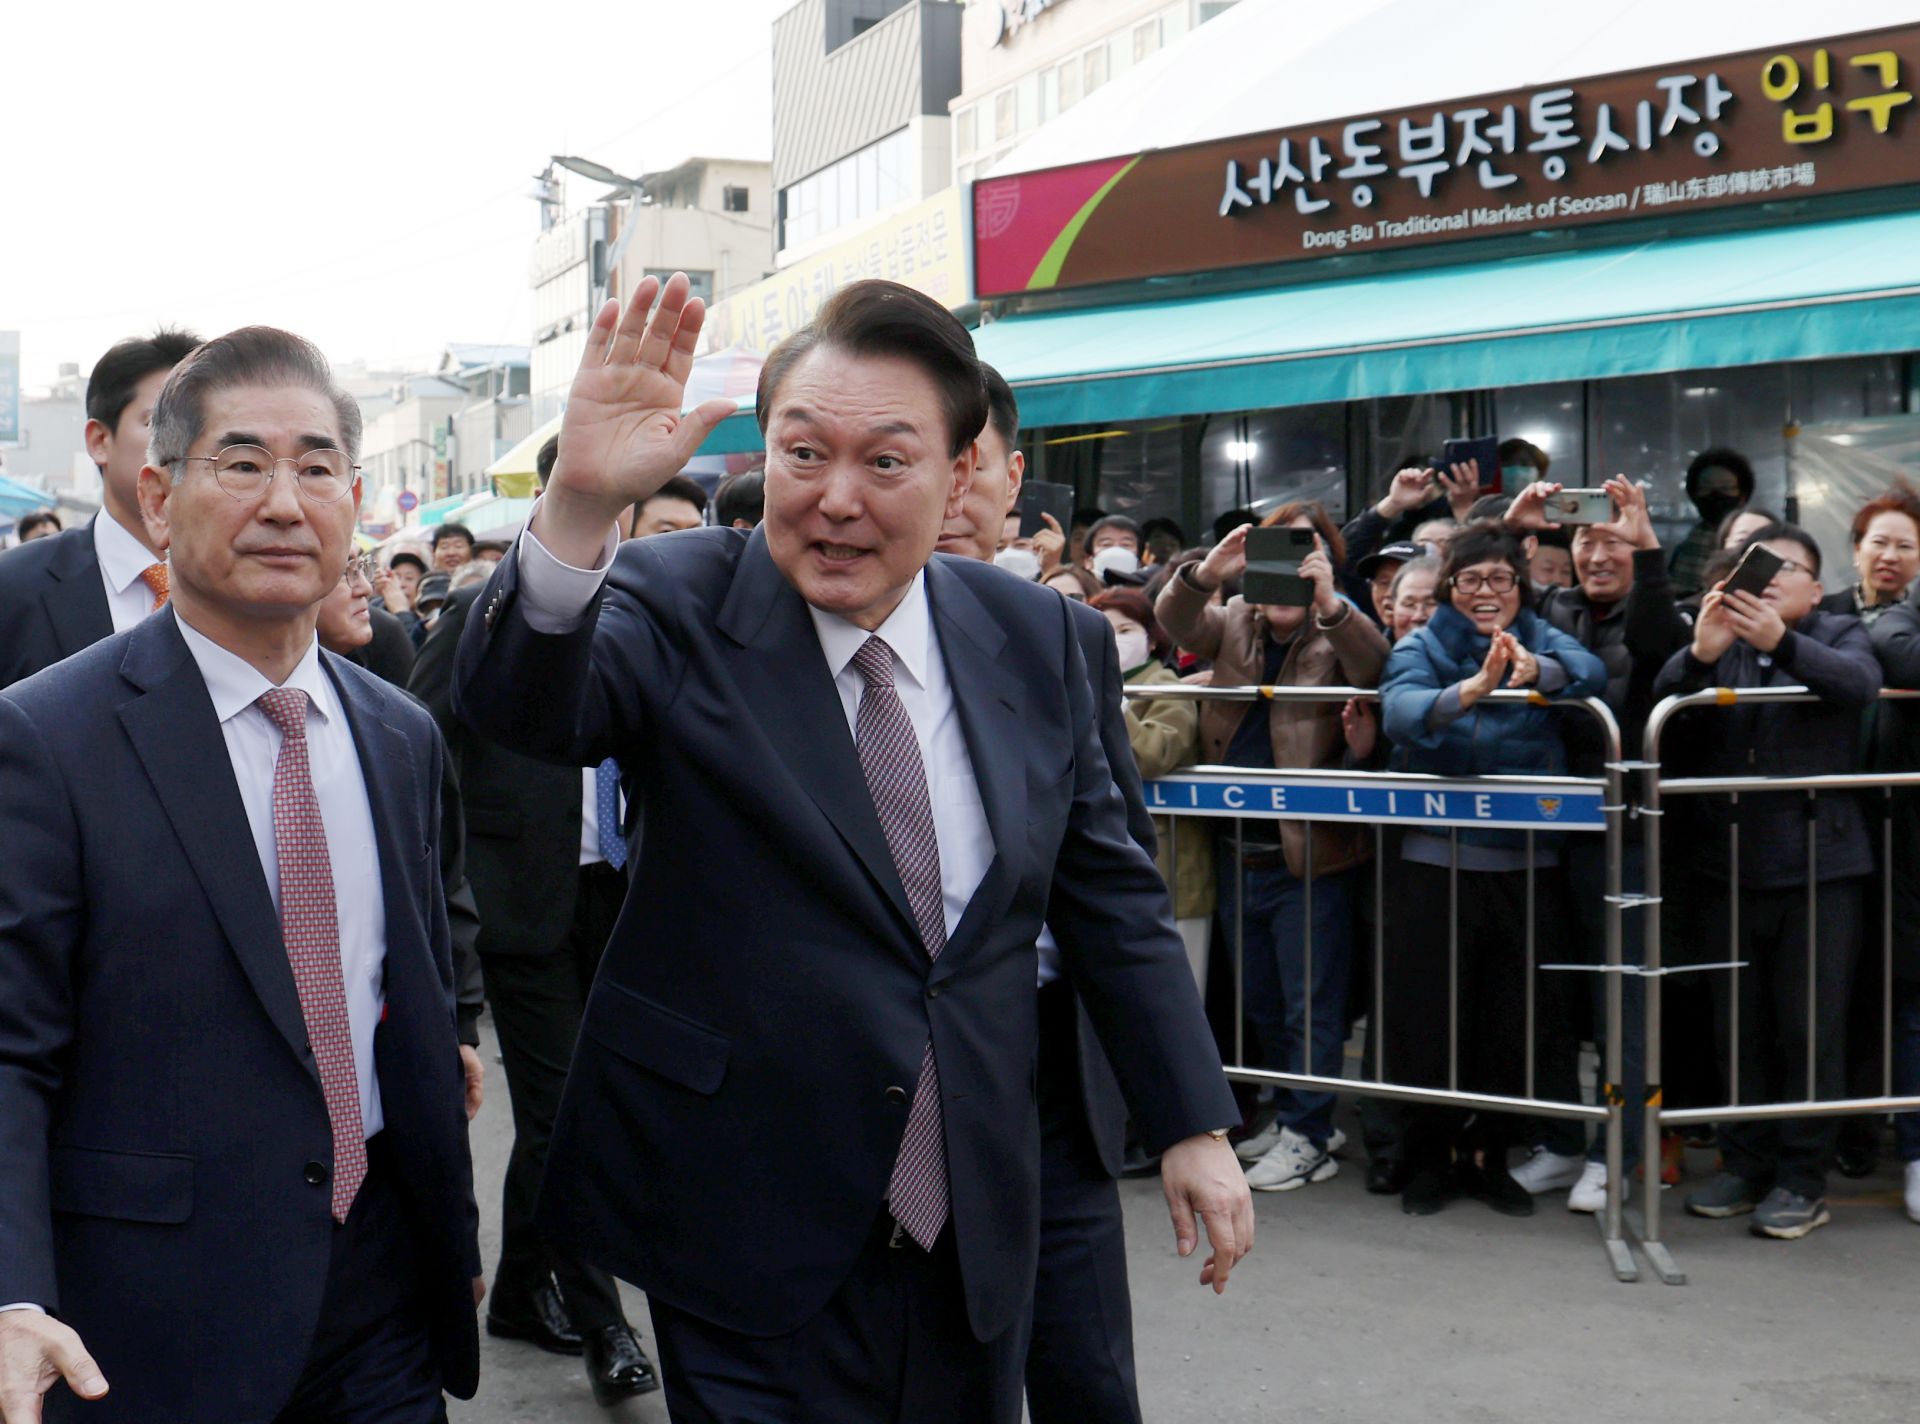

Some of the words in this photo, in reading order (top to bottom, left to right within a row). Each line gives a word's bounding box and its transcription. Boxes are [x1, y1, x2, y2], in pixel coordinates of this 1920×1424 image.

[1218, 73, 1732, 217] 서산동부전통시장
[1761, 48, 1912, 144] 입구
[1303, 222, 1374, 250] Dong-Bu
[1377, 209, 1468, 239] Traditional
[1472, 201, 1533, 226] Market
[1536, 196, 1556, 218] of
[1558, 190, 1628, 216] Seosan
[1629, 185, 1641, 212] /
[1153, 783, 1287, 811] LICE
[1347, 789, 1492, 819] LINE
